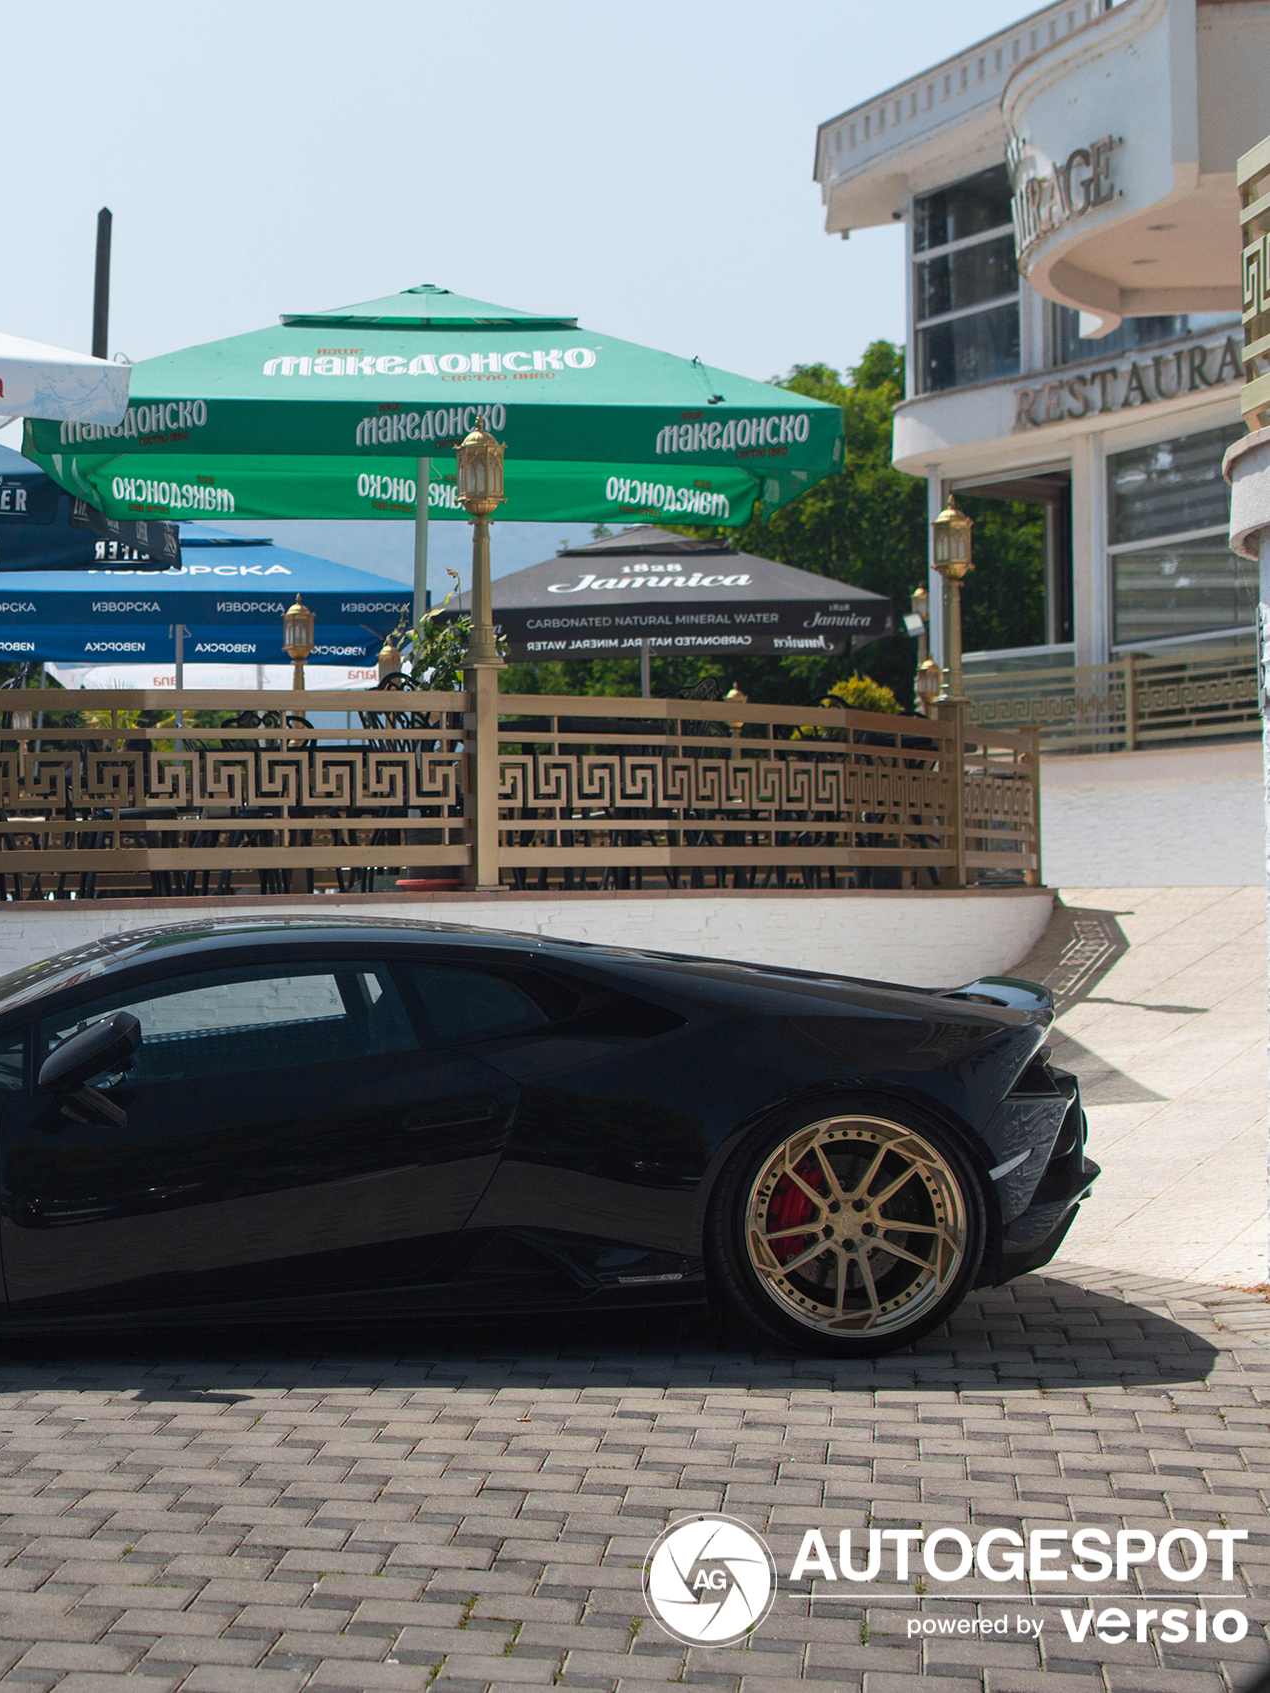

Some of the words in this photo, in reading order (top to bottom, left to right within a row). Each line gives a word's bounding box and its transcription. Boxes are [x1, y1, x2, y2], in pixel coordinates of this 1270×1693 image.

[1013, 335, 1246, 434] RESTAURA
[620, 563, 683, 574] 1828
[546, 572, 753, 594] Jamnica
[92, 601, 161, 613] ИЗВОРСКА
[216, 601, 285, 613] ИЗВОРСКА
[526, 616, 612, 630] CARBONATED
[614, 615, 673, 627] NATURAL
[675, 613, 732, 625] MINERAL
[734, 613, 779, 625] WATER
[803, 611, 872, 629] Jamnica
